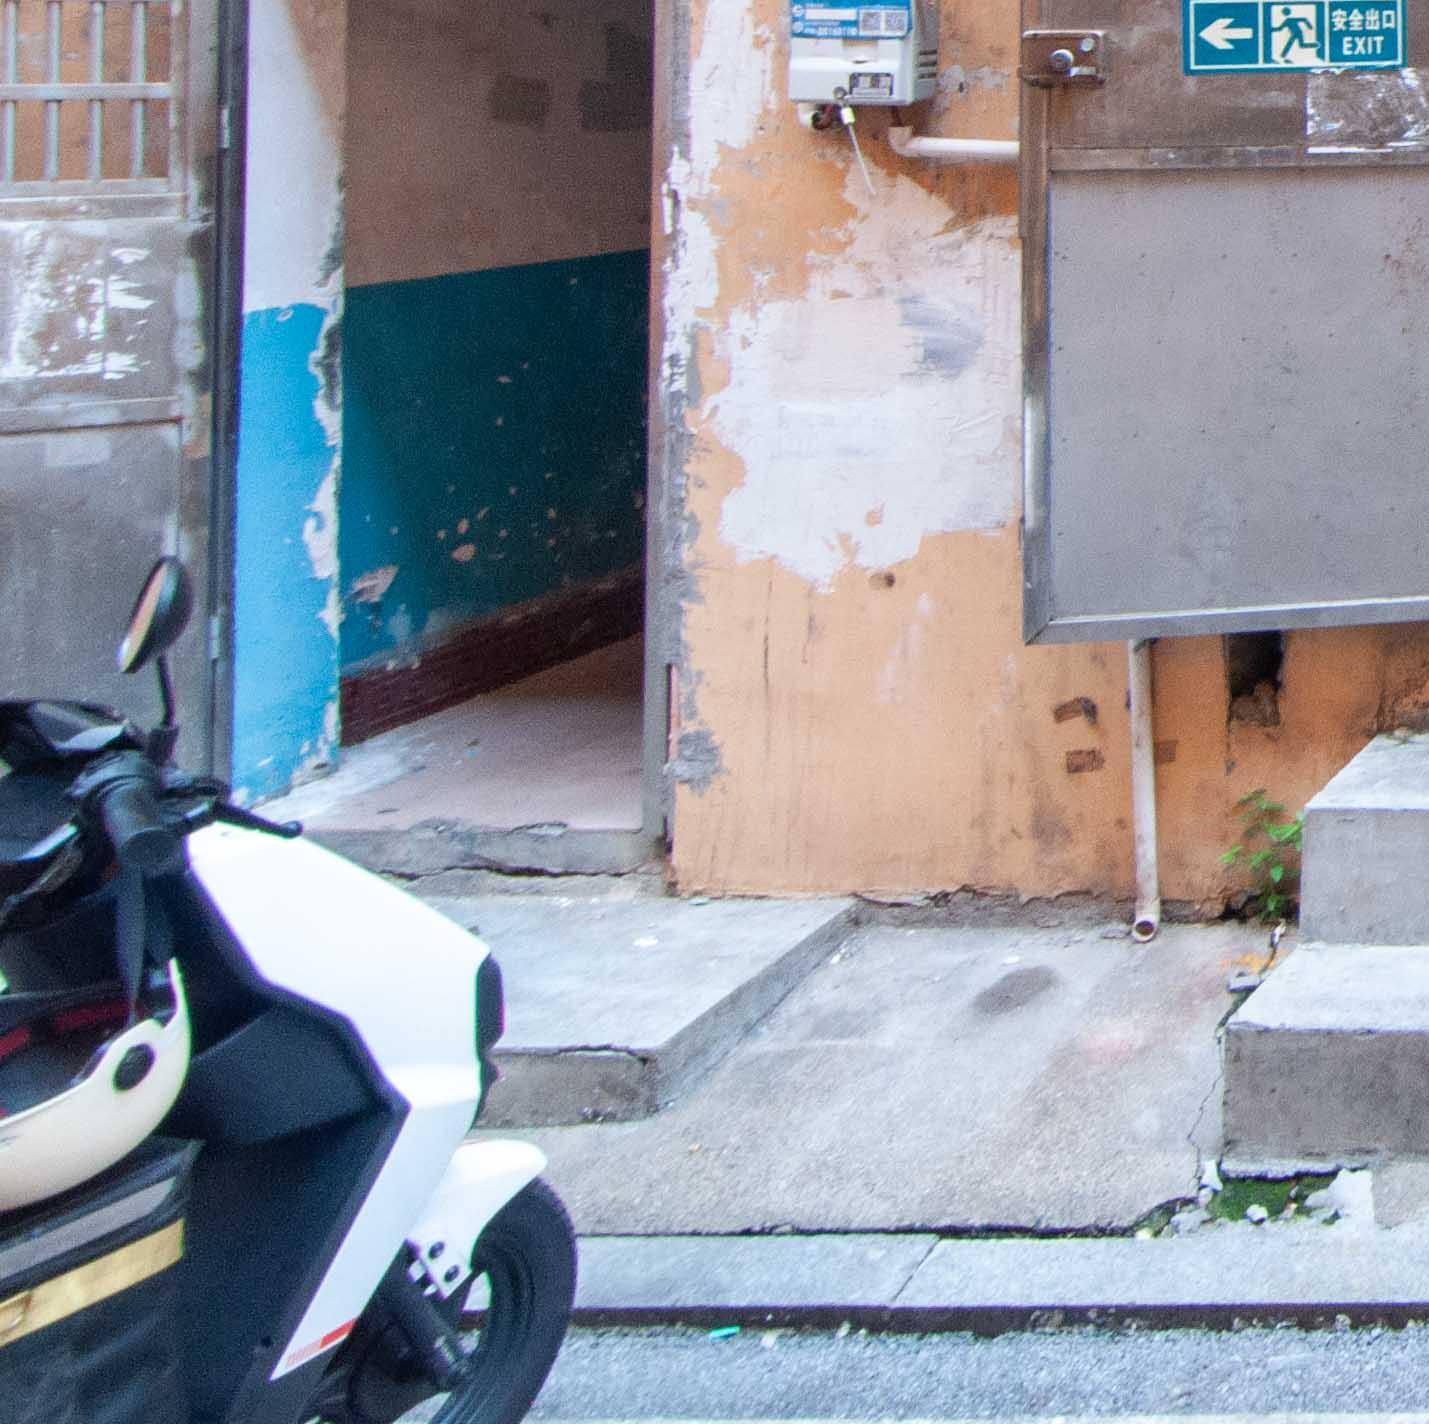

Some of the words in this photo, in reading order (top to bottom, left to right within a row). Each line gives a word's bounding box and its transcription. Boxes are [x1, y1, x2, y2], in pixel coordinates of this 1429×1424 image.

[1331, 8, 1396, 32] 安全出口
[1342, 36, 1385, 56] EXIT
